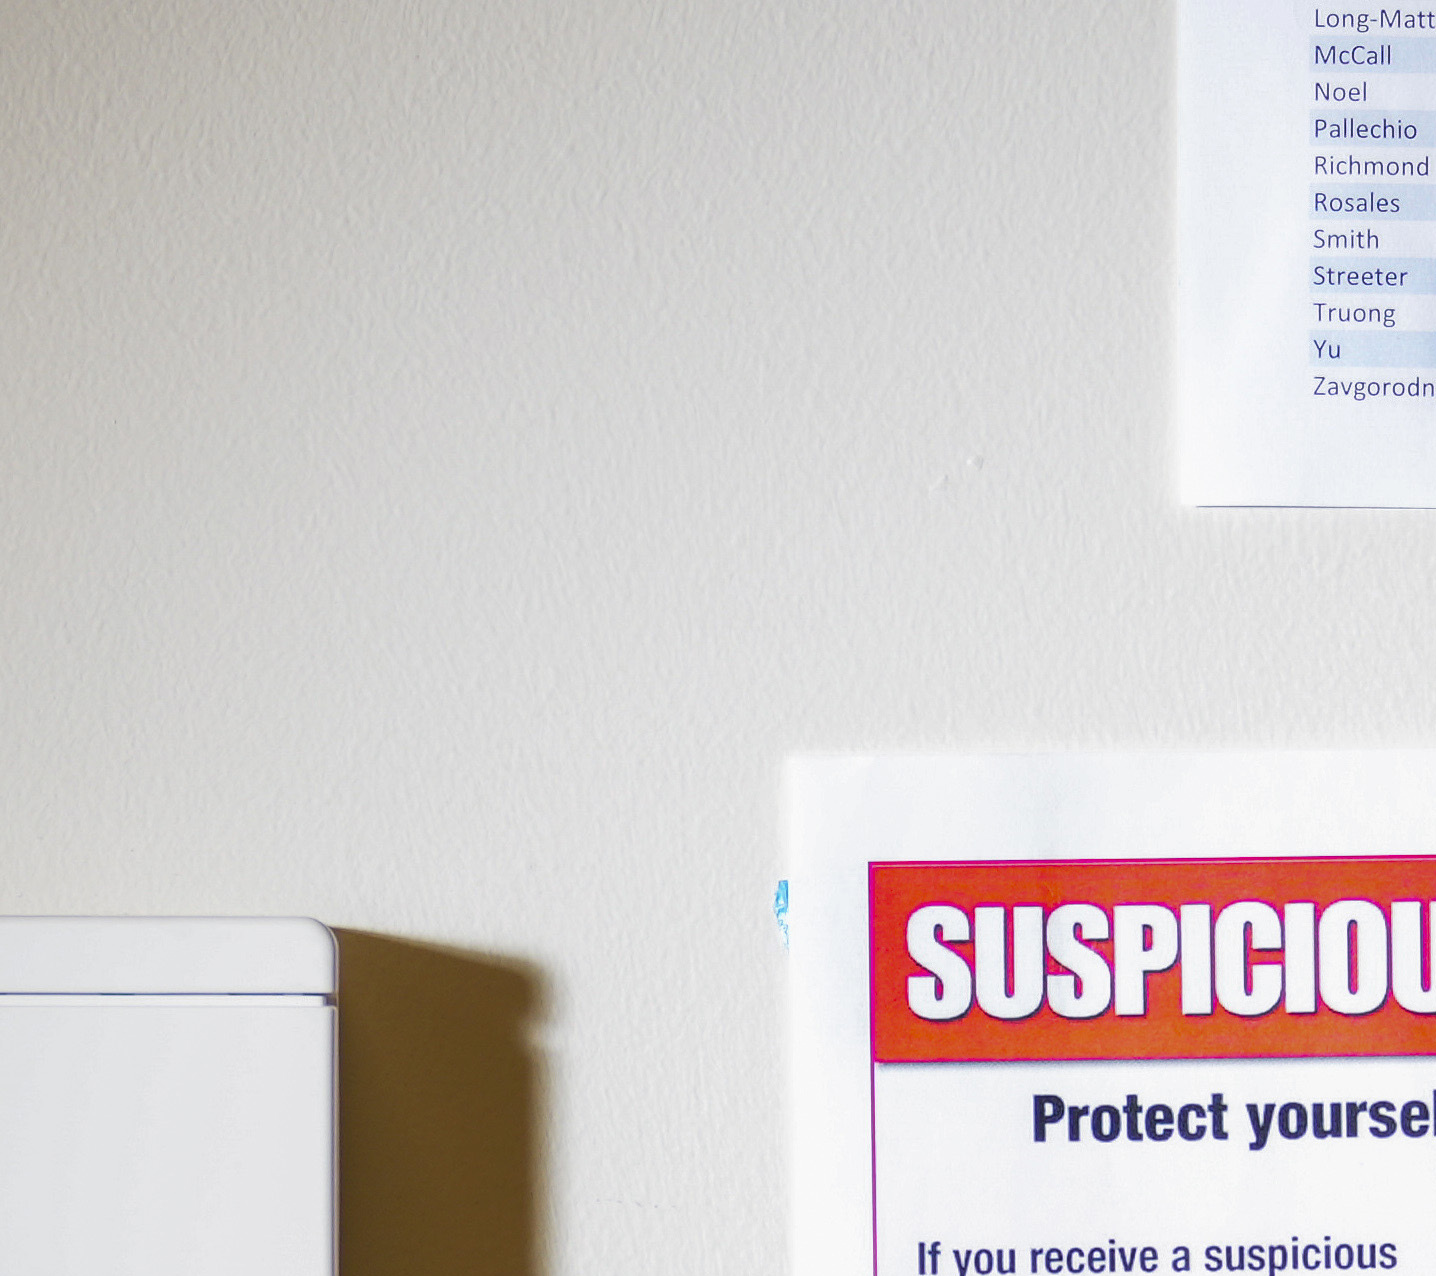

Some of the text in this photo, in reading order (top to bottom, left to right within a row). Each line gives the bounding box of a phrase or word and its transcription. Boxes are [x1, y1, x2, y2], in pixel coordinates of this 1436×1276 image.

[1315, 44, 1391, 66] McCall
[1315, 117, 1417, 140] Pallechio
[1314, 191, 1400, 213] Rosales
[1313, 265, 1409, 287] Streeter
[1033, 1092, 1229, 1143] Protect
[918, 1240, 942, 1276] If
[1030, 1238, 1159, 1275] receive
[1171, 1245, 1191, 1273] a
